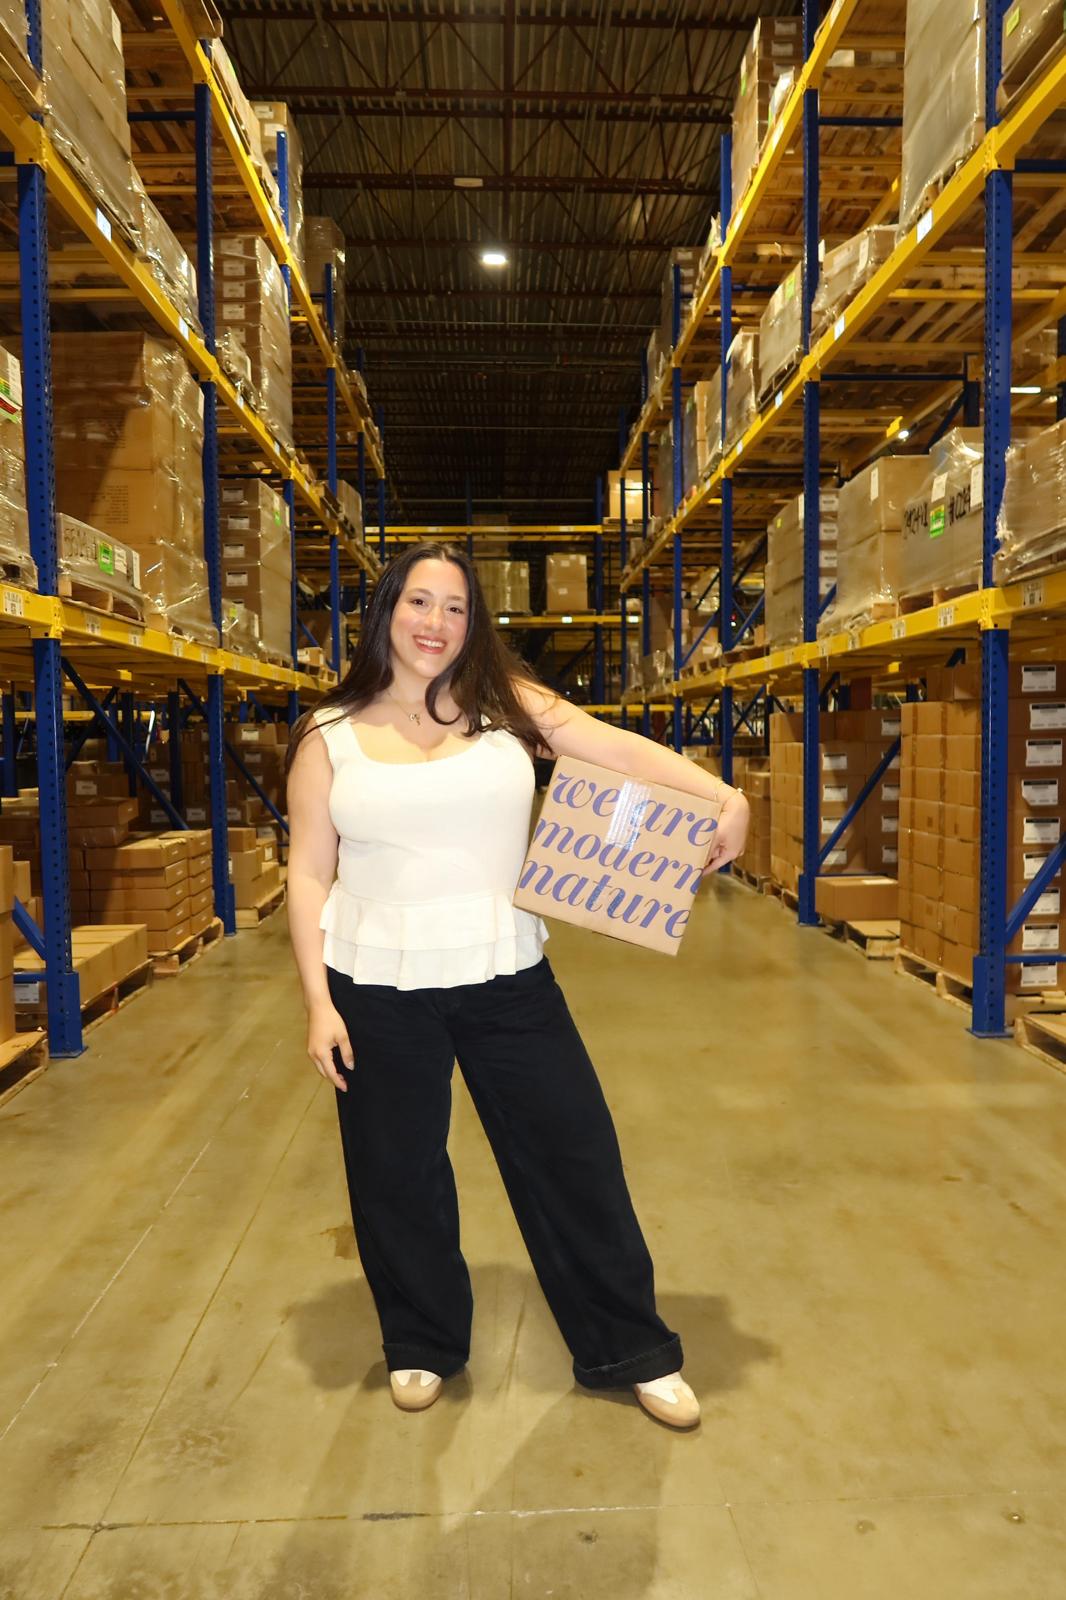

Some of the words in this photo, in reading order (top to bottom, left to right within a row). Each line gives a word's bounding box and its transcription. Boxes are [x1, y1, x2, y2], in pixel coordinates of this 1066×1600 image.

[552, 772, 621, 817] we
[630, 799, 718, 847] are
[533, 818, 704, 895] modern
[518, 860, 691, 938] nature
